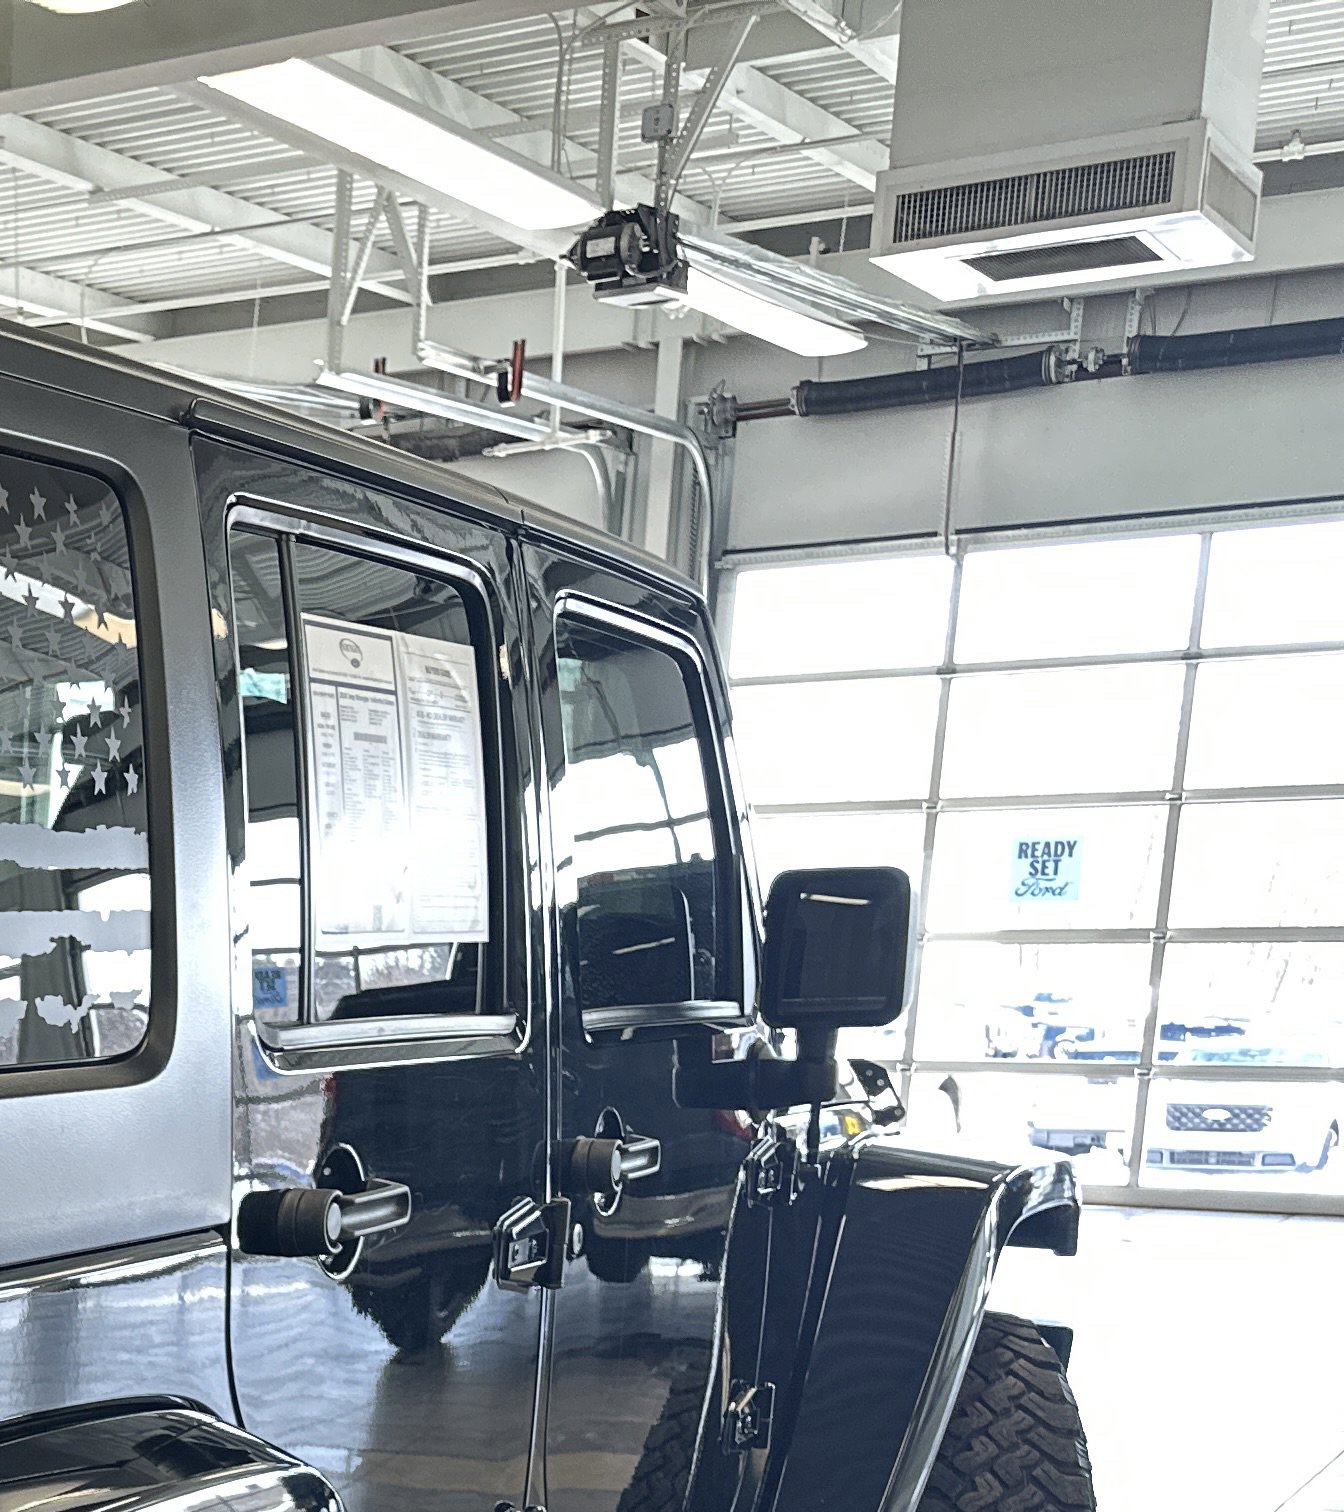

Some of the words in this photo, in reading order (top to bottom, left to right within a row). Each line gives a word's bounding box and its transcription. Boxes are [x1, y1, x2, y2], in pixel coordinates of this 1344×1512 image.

[1018, 840, 1077, 859] READY
[1028, 858, 1062, 876] SET
[1014, 877, 1070, 896] Ford
